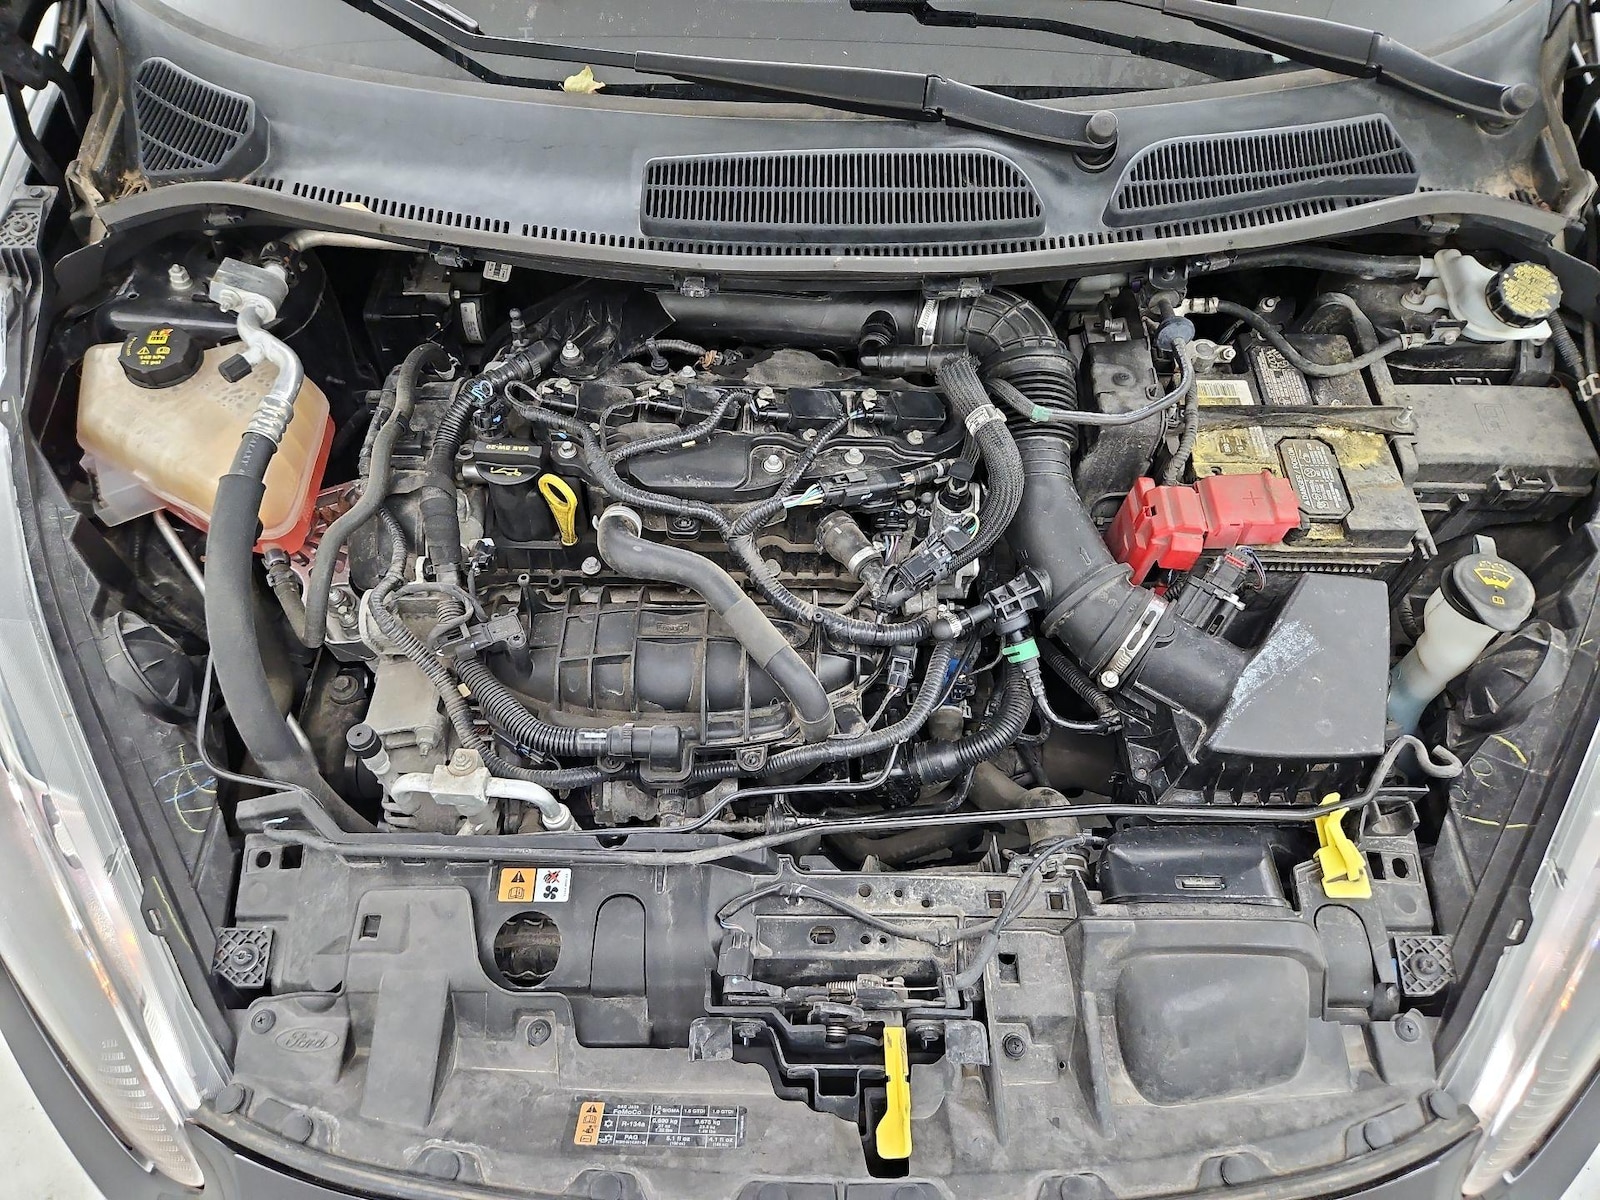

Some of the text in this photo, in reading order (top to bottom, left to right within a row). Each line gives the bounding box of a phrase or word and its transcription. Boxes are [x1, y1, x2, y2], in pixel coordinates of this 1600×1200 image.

[1287, 447, 1299, 470] POISON
[1295, 474, 1310, 500] DANGER
[285, 1031, 329, 1049] Ford
